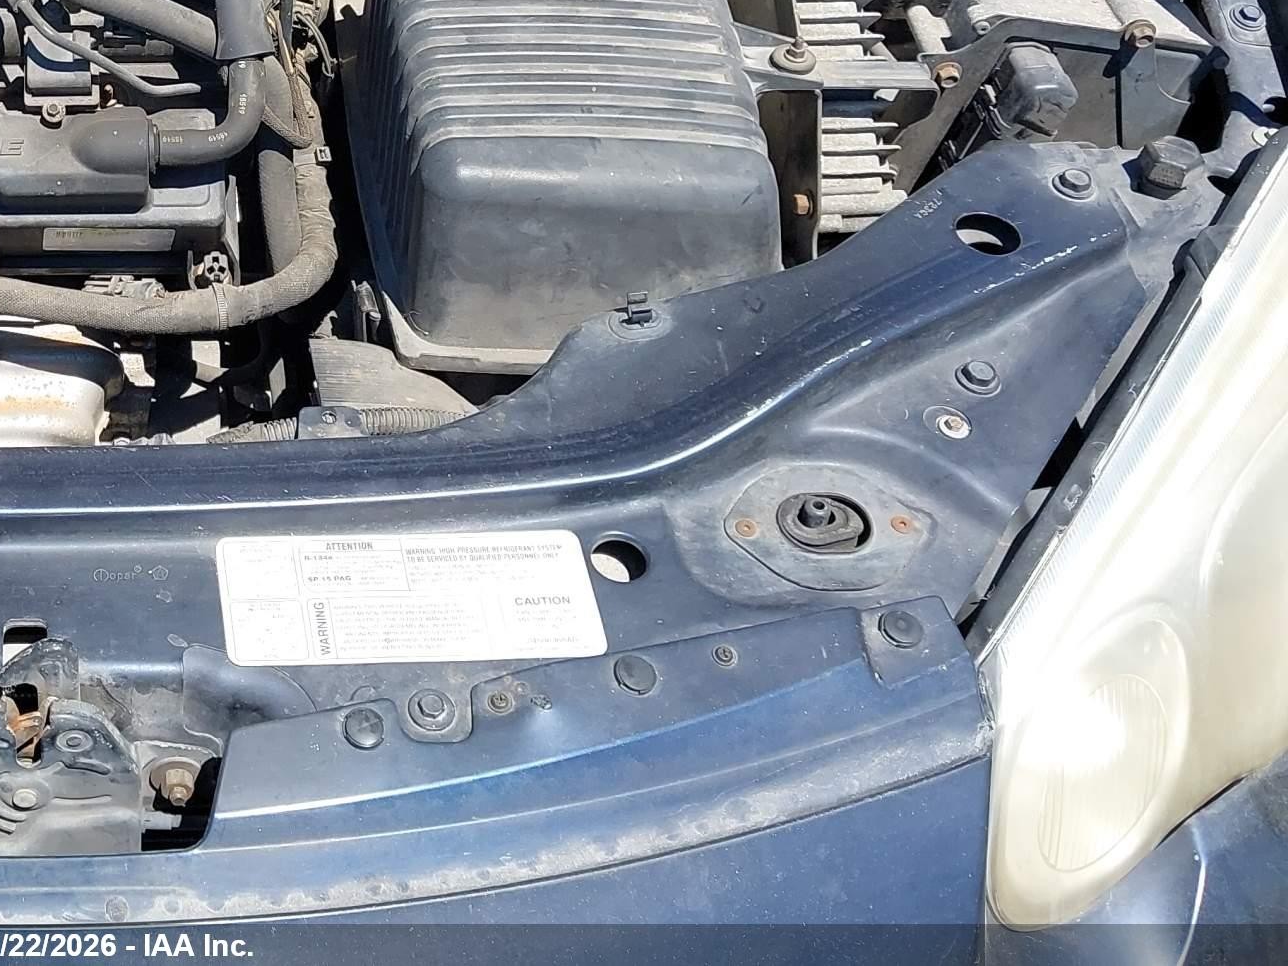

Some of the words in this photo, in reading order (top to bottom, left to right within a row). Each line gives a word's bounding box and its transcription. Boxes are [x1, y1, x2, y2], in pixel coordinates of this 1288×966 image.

[325, 542, 374, 552] ATTENTION
[514, 595, 572, 607] CAUTION
[313, 601, 332, 656] WARNING
